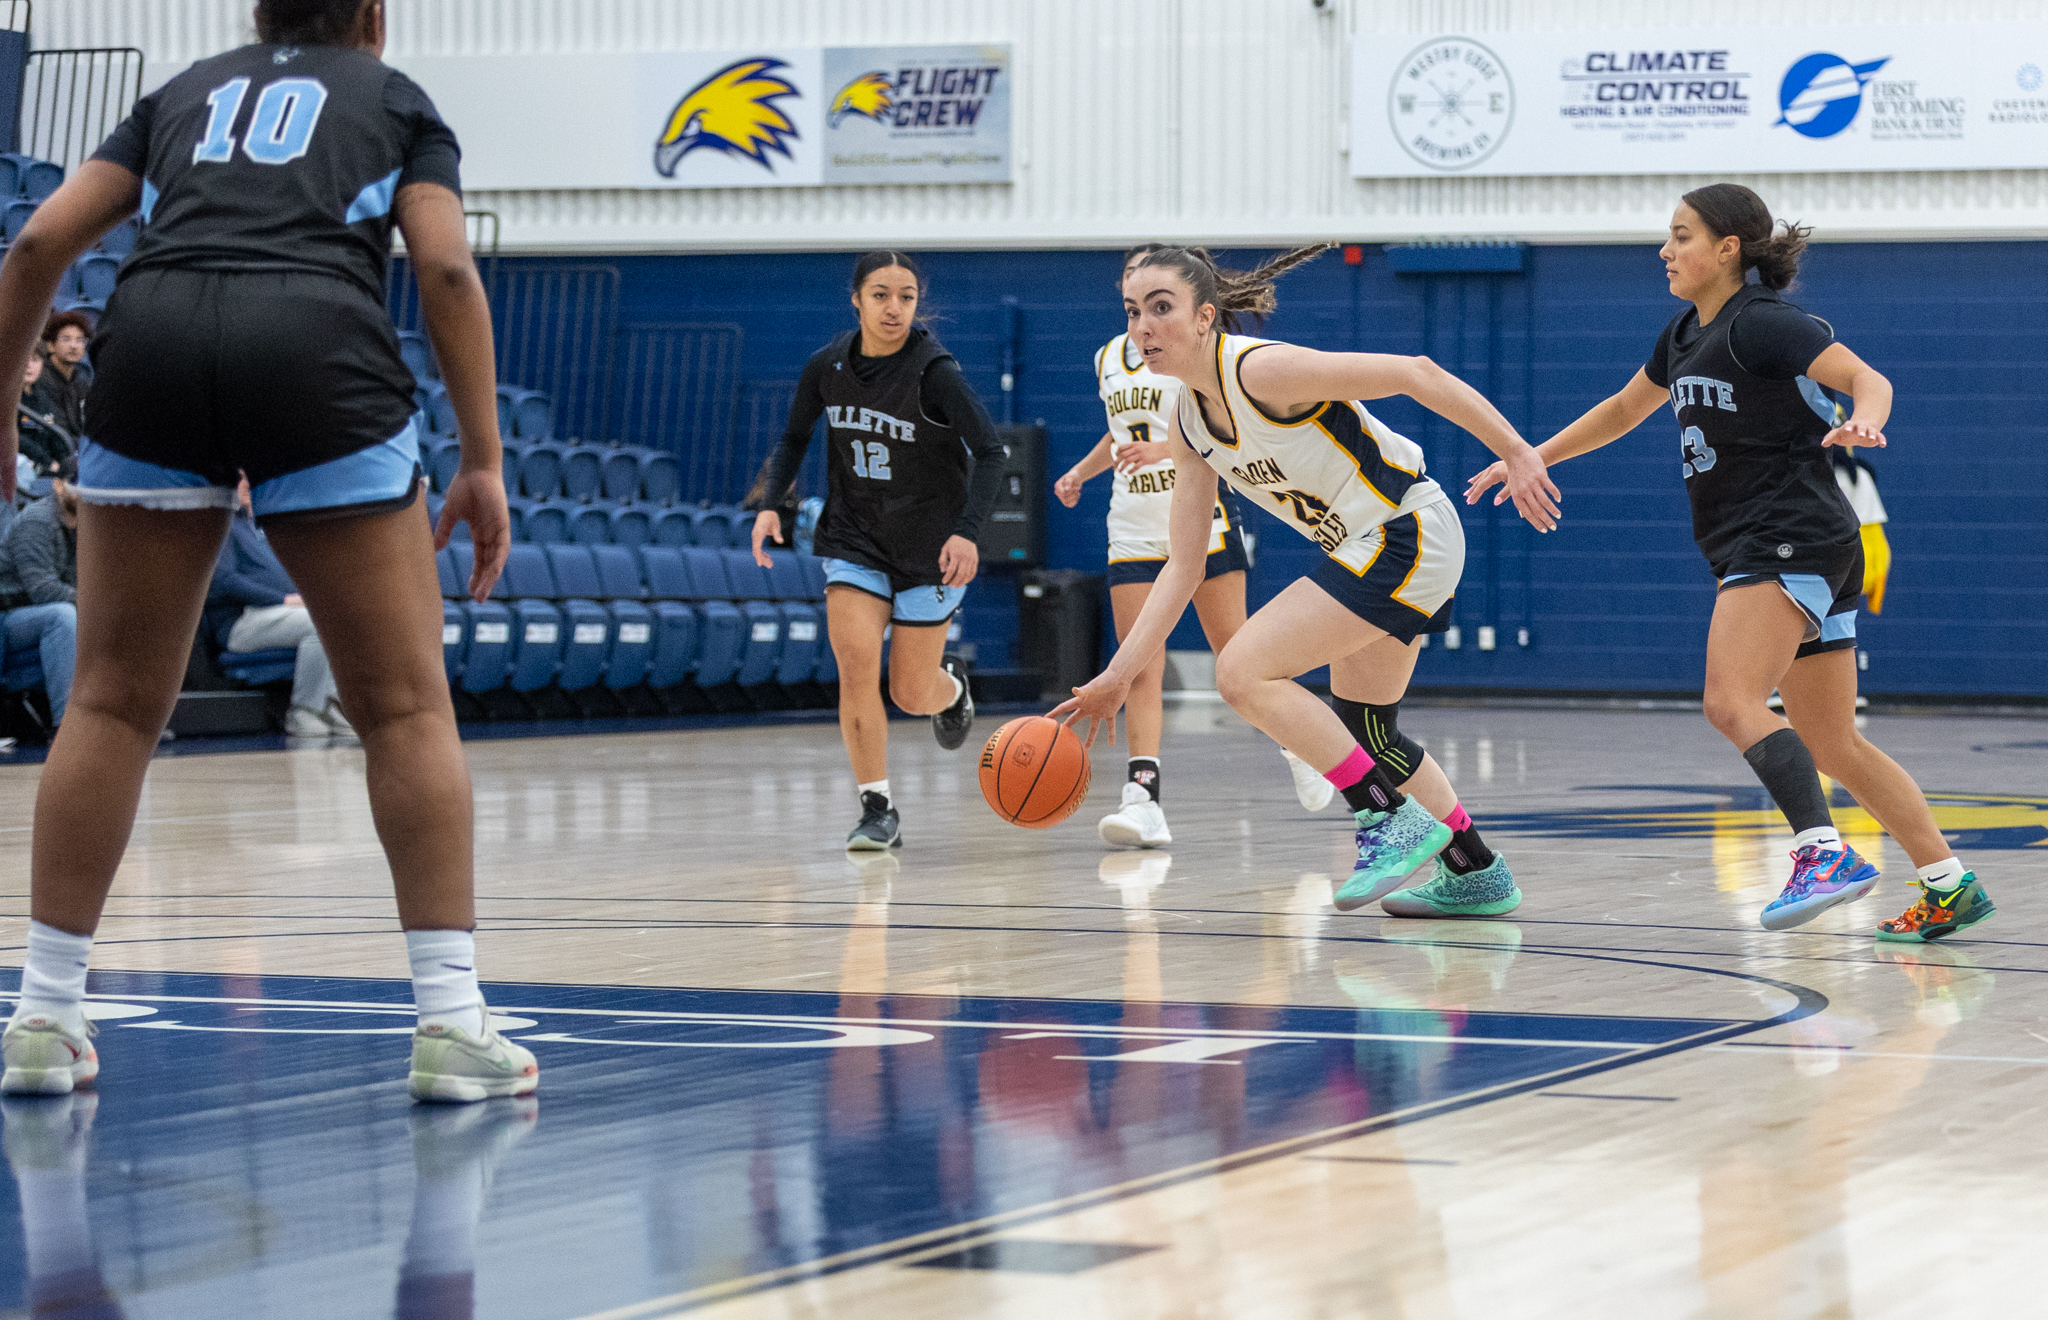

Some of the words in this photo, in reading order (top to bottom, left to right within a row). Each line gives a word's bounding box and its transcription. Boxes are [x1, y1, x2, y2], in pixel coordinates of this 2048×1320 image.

[1586, 51, 1729, 73] CLIMATE
[895, 66, 1001, 95] FLIGHT
[1597, 81, 1749, 102] CONTROL
[1872, 80, 1919, 98] FIRST
[894, 98, 984, 127] CREW
[1560, 105, 1613, 117] HEATING
[1633, 105, 1653, 116] AIR
[1657, 104, 1749, 116] CONDITIONING
[1872, 97, 1966, 116] WYOMING
[192, 75, 328, 166] 10
[1871, 117, 1909, 130] BANK
[1107, 387, 1162, 417] GOLDEN
[851, 440, 892, 480] 12
[1124, 469, 1175, 493] AGLES
